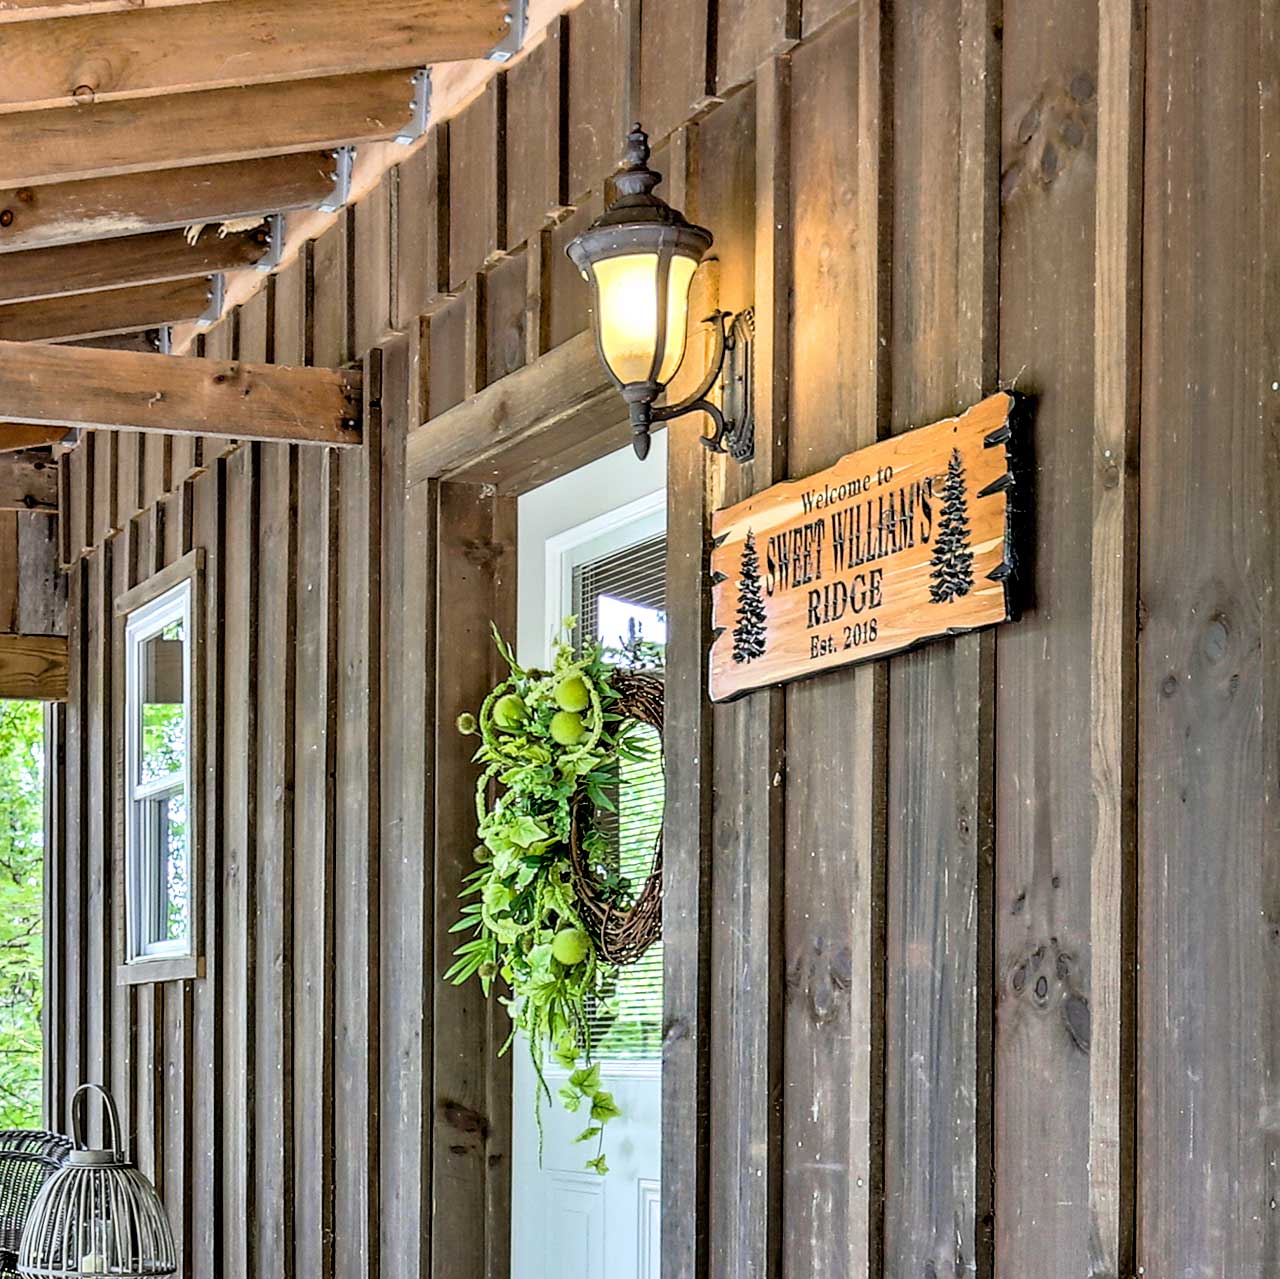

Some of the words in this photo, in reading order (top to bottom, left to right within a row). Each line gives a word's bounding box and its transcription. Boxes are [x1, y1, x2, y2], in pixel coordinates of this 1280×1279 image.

[801, 473, 871, 515] Welcome
[877, 465, 893, 487] to
[765, 518, 825, 597] SWEET
[831, 477, 932, 574] WILLIAM'S
[806, 568, 883, 629] RIDGE
[810, 634, 837, 660] Est.
[843, 618, 878, 650] 2018
